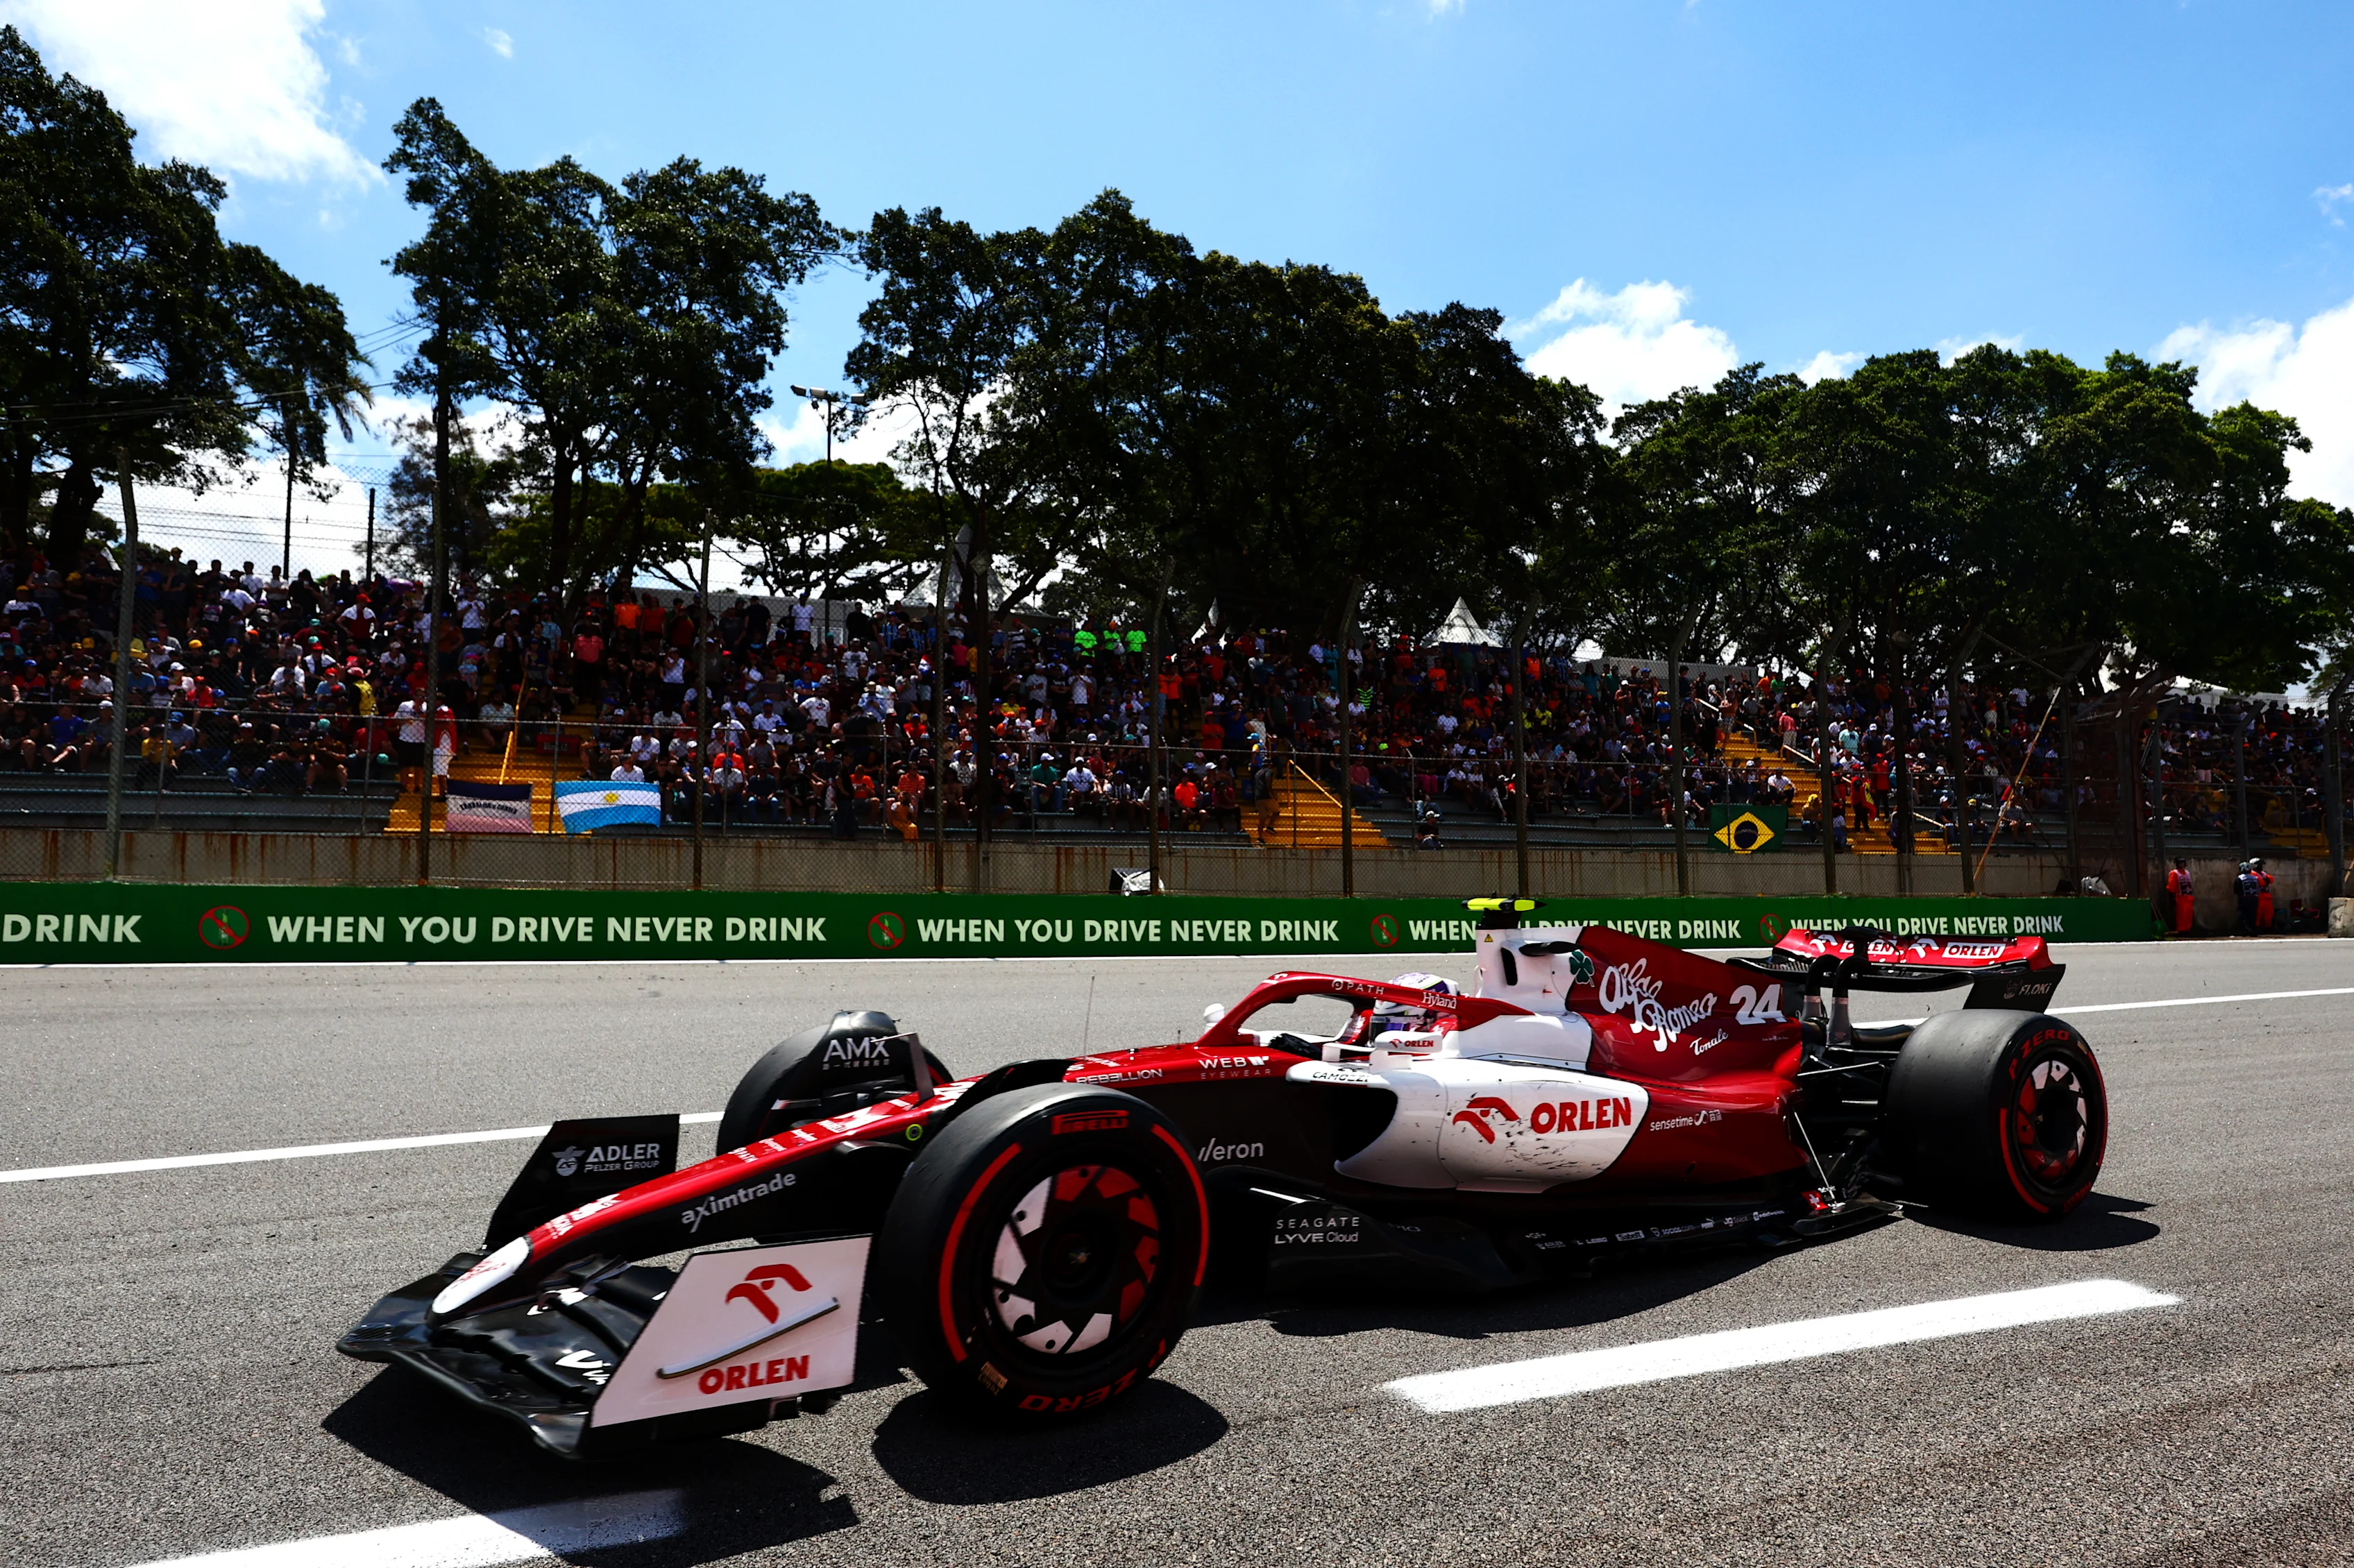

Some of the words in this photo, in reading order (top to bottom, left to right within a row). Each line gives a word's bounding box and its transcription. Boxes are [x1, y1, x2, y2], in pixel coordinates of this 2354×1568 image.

[3, 914, 142, 943] DRINK
[268, 916, 385, 944] WHEN
[399, 917, 477, 944] YOU
[491, 917, 593, 943] DRIVE
[607, 917, 713, 942] NEVER
[725, 918, 827, 942] DRINK
[917, 919, 1005, 943] WHEN
[1014, 919, 1074, 944] YOU
[1085, 920, 1162, 942] DRIVE
[1171, 920, 1253, 942] NEVER
[1260, 921, 1340, 942] DRINK
[1409, 920, 1476, 941] WHEN
[1607, 920, 1673, 939] NEVER
[1678, 920, 1742, 939] DRINK
[1898, 917, 1949, 936] DRIVE
[1954, 917, 2008, 935] NEVER
[2013, 915, 2065, 935] DRINK
[1845, 940, 1892, 953] OEN
[1948, 944, 2001, 957] ORLEN
[1347, 982, 1385, 996] PATH
[1599, 957, 1663, 1015] Alfa
[1422, 992, 1458, 1010] Hyland
[1729, 983, 1787, 1025] 24
[1629, 992, 1718, 1053] Romeo
[822, 1035, 890, 1062] AMX
[1405, 1039, 1434, 1048] ORLEN
[1689, 1028, 1729, 1056] Tonale
[2021, 1028, 2069, 1059] ZERO
[1200, 1068, 1271, 1080] EYEWEAR
[1312, 1071, 1369, 1083] CAMOZZI
[1530, 1097, 1632, 1134] ORLEN
[1650, 1116, 1694, 1132] sensetime
[586, 1143, 661, 1163] ADLER
[584, 1163, 622, 1173] PELZER
[623, 1160, 660, 1171] GROUP
[680, 1173, 797, 1234] aximtrade
[1276, 1216, 1361, 1230] SEAGATE
[1274, 1233, 1325, 1245] LYVE
[1326, 1232, 1360, 1243] Cloud
[698, 1354, 811, 1395] ORLEN
[1017, 1367, 1138, 1413] ZERO
